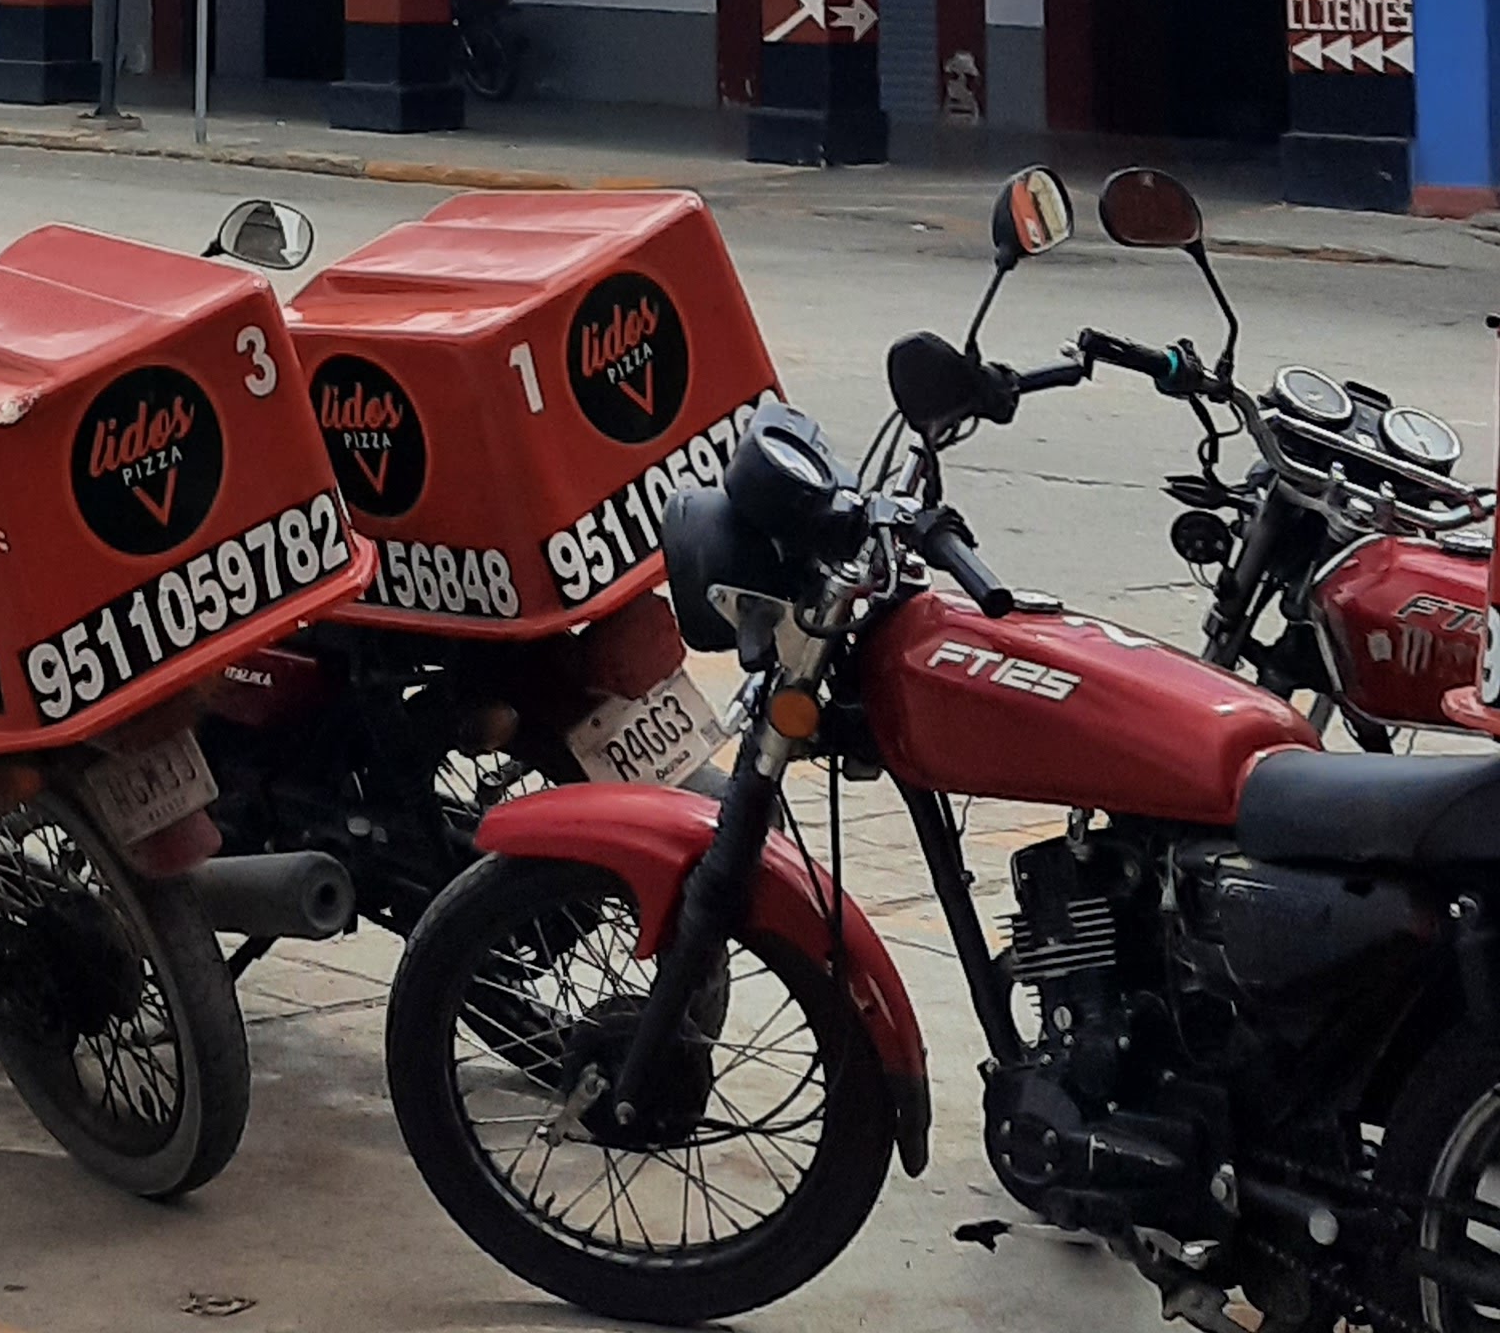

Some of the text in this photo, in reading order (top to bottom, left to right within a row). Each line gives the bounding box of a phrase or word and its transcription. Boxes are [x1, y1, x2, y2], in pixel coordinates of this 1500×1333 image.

[236, 325, 277, 397] 3
[508, 341, 544, 415] 1
[606, 341, 654, 384] PIZZA
[121, 445, 183, 486] PIZZA
[343, 432, 392, 450] PIZZA
[27, 493, 349, 721] 9511059782
[926, 641, 1083, 701] FT125
